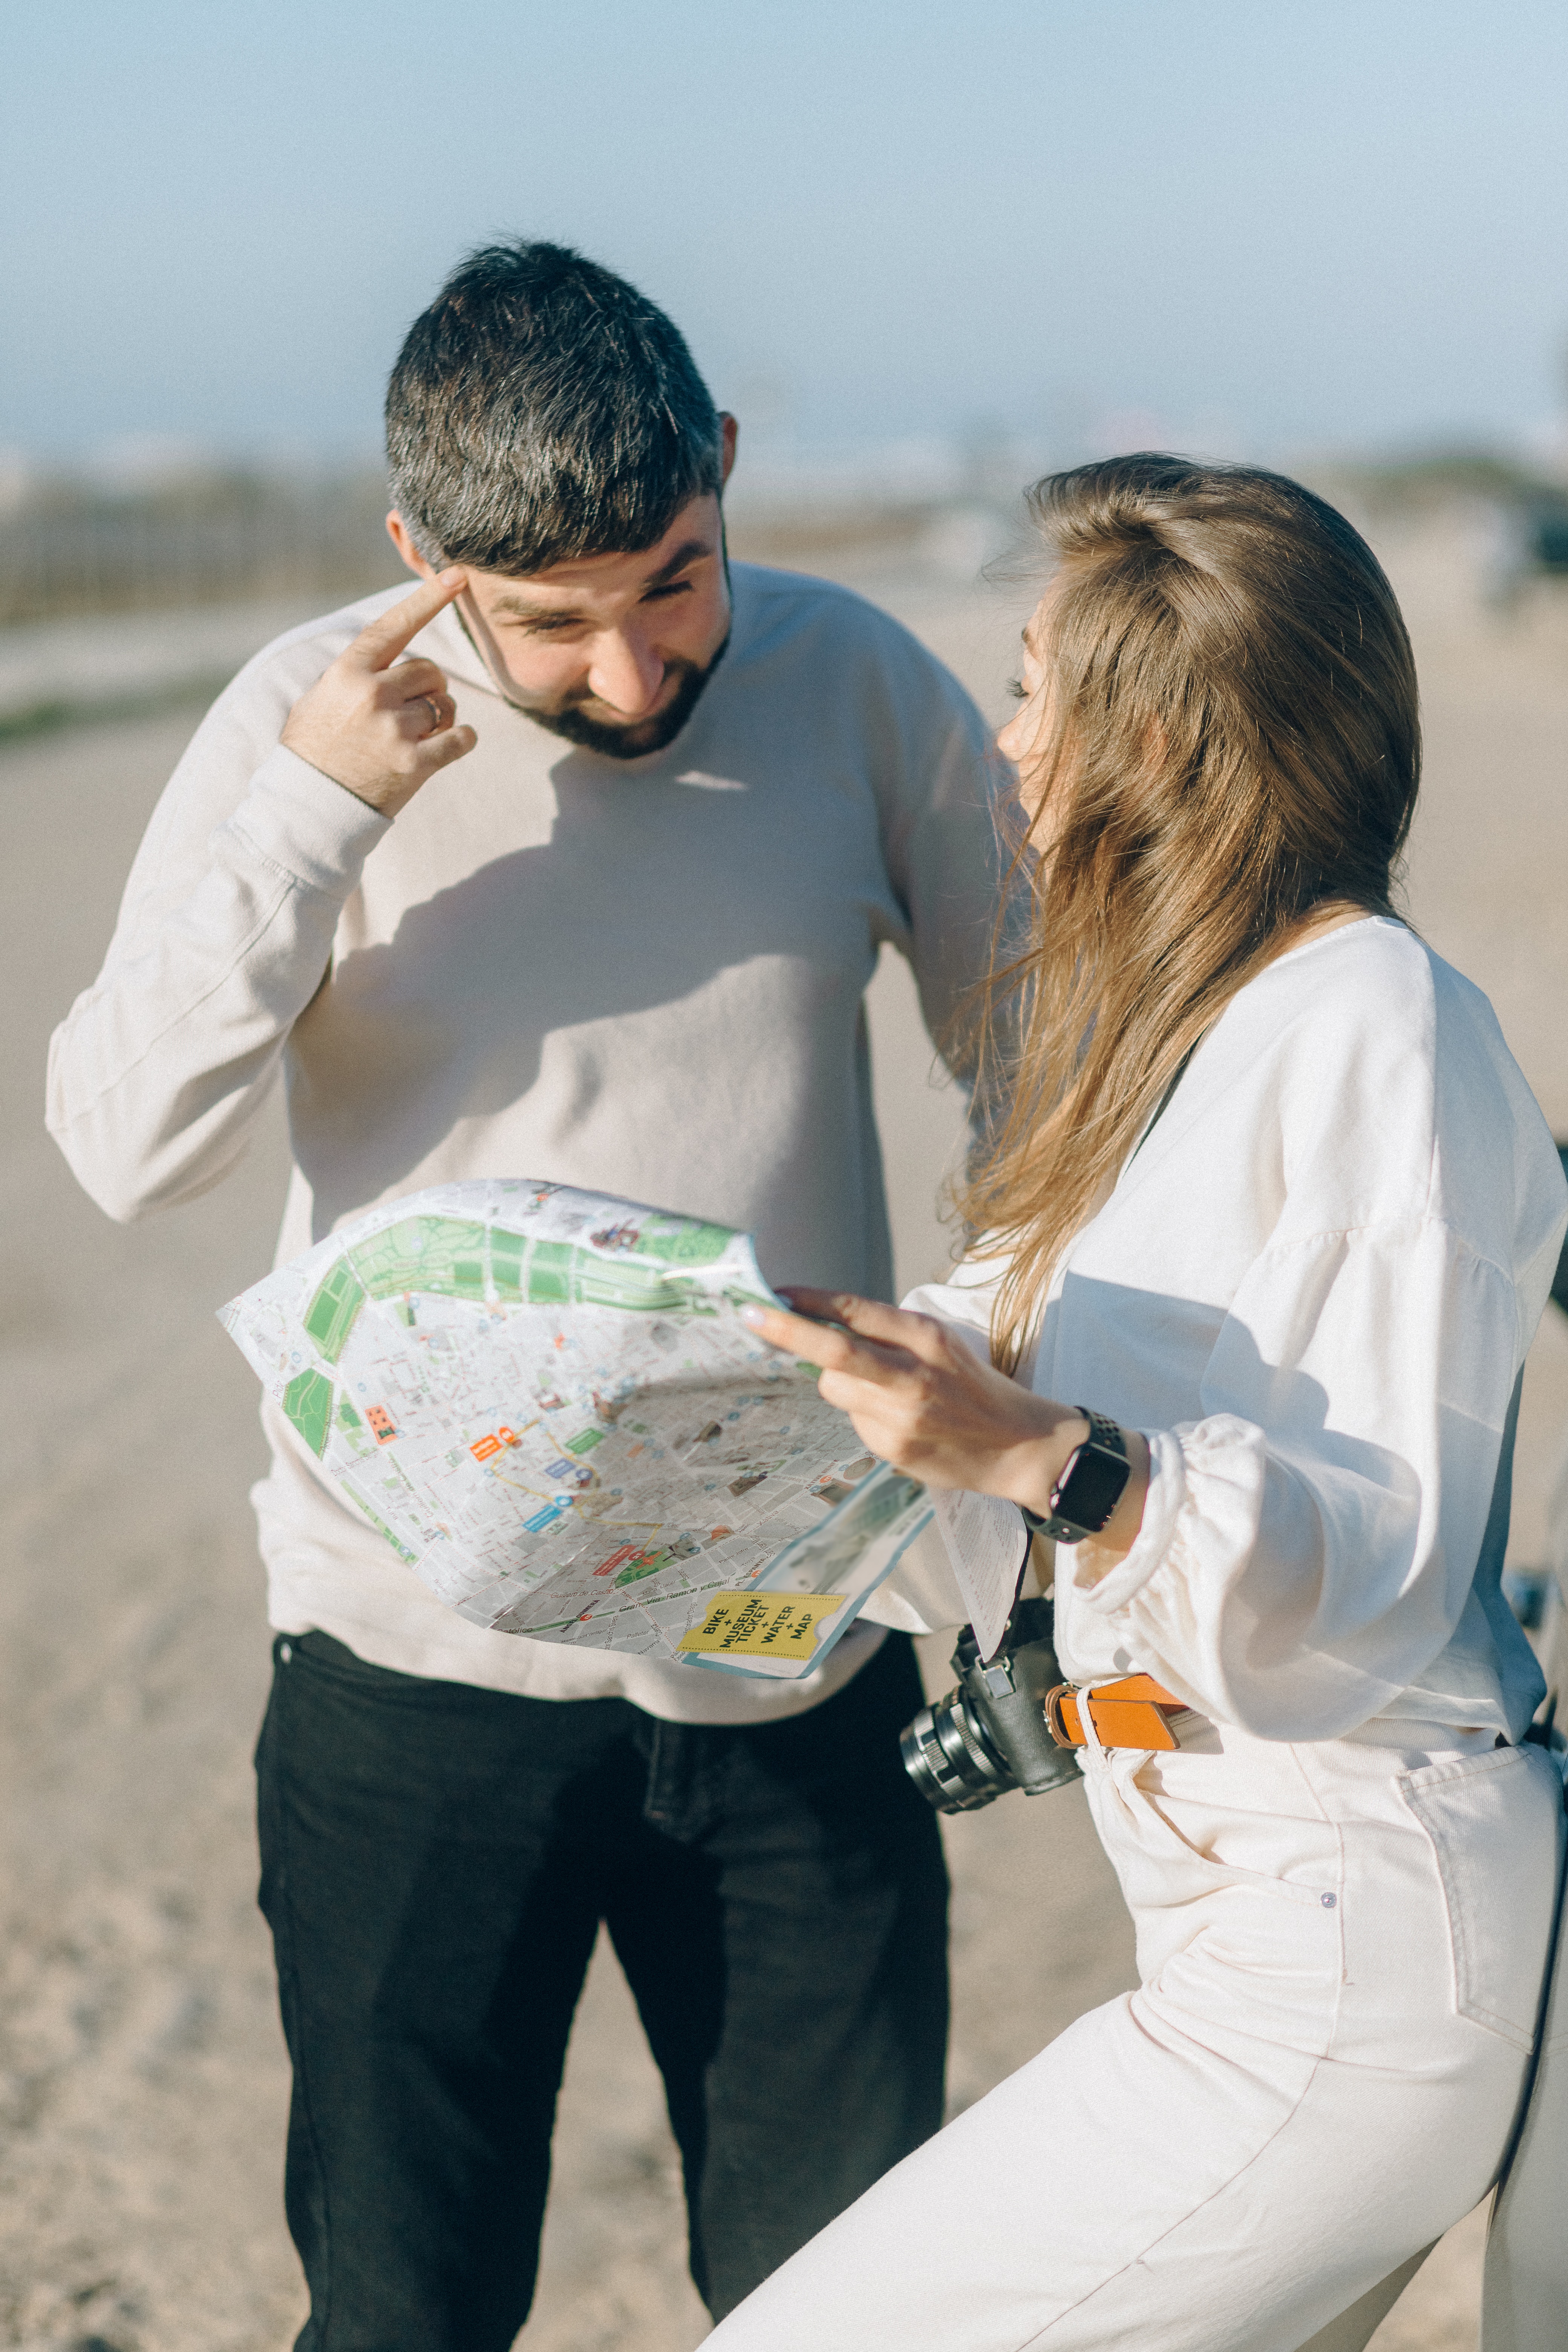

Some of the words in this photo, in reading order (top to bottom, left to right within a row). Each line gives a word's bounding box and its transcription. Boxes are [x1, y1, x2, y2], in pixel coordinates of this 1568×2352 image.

[719, 1553, 735, 1563] Padre
[741, 1557, 755, 1566] Troya
[743, 1558, 766, 1578] ESPANYA
[619, 1603, 641, 1612] Gran
[666, 1587, 697, 1600] Ramon
[707, 1577, 730, 1588] Cajal
[687, 1602, 697, 1614] Diago
[702, 1608, 729, 1634] BIKE
[719, 1599, 762, 1648] MUSEUM
[735, 1605, 769, 1643] TICKET
[760, 1606, 795, 1644] WATER
[790, 1614, 813, 1639] MAP
[605, 1627, 615, 1643] Sanchis
[626, 1630, 649, 1639] Palleter
[637, 1640, 660, 1655] Navarra
